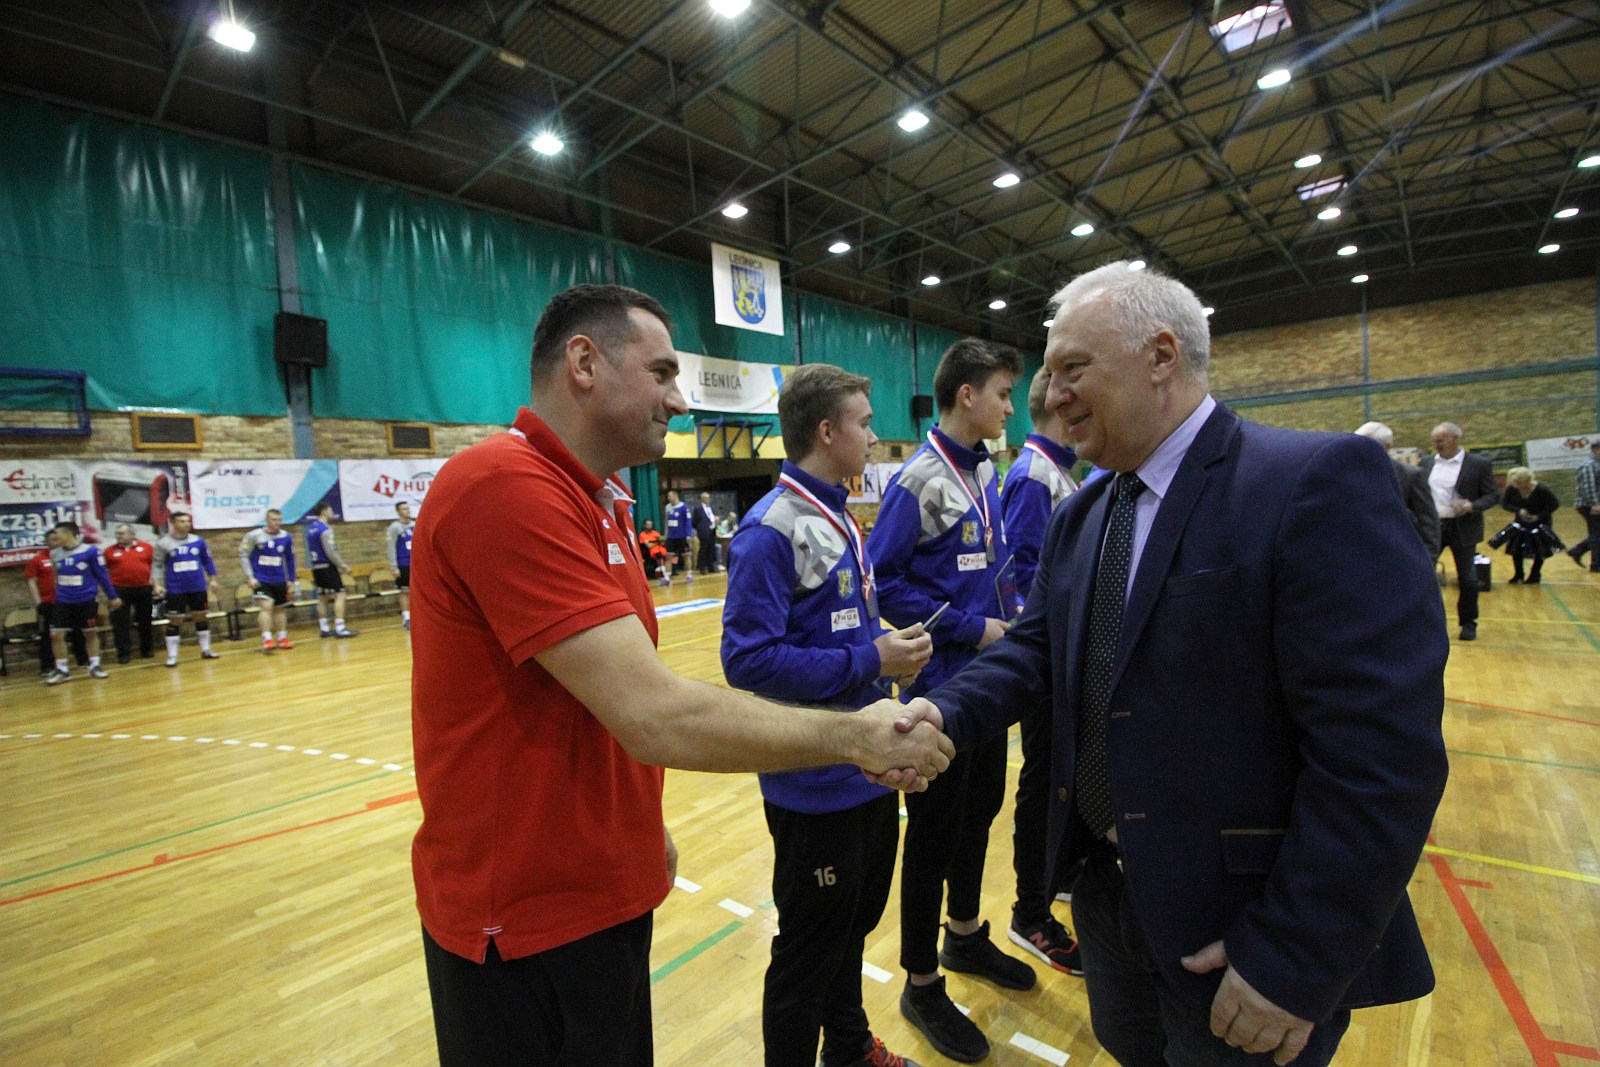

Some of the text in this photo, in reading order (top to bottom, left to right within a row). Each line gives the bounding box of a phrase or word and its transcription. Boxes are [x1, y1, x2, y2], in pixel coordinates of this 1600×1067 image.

[728, 253, 763, 269] LEGNICA
[699, 371, 742, 390] LEGNICA
[813, 866, 837, 888] 16
